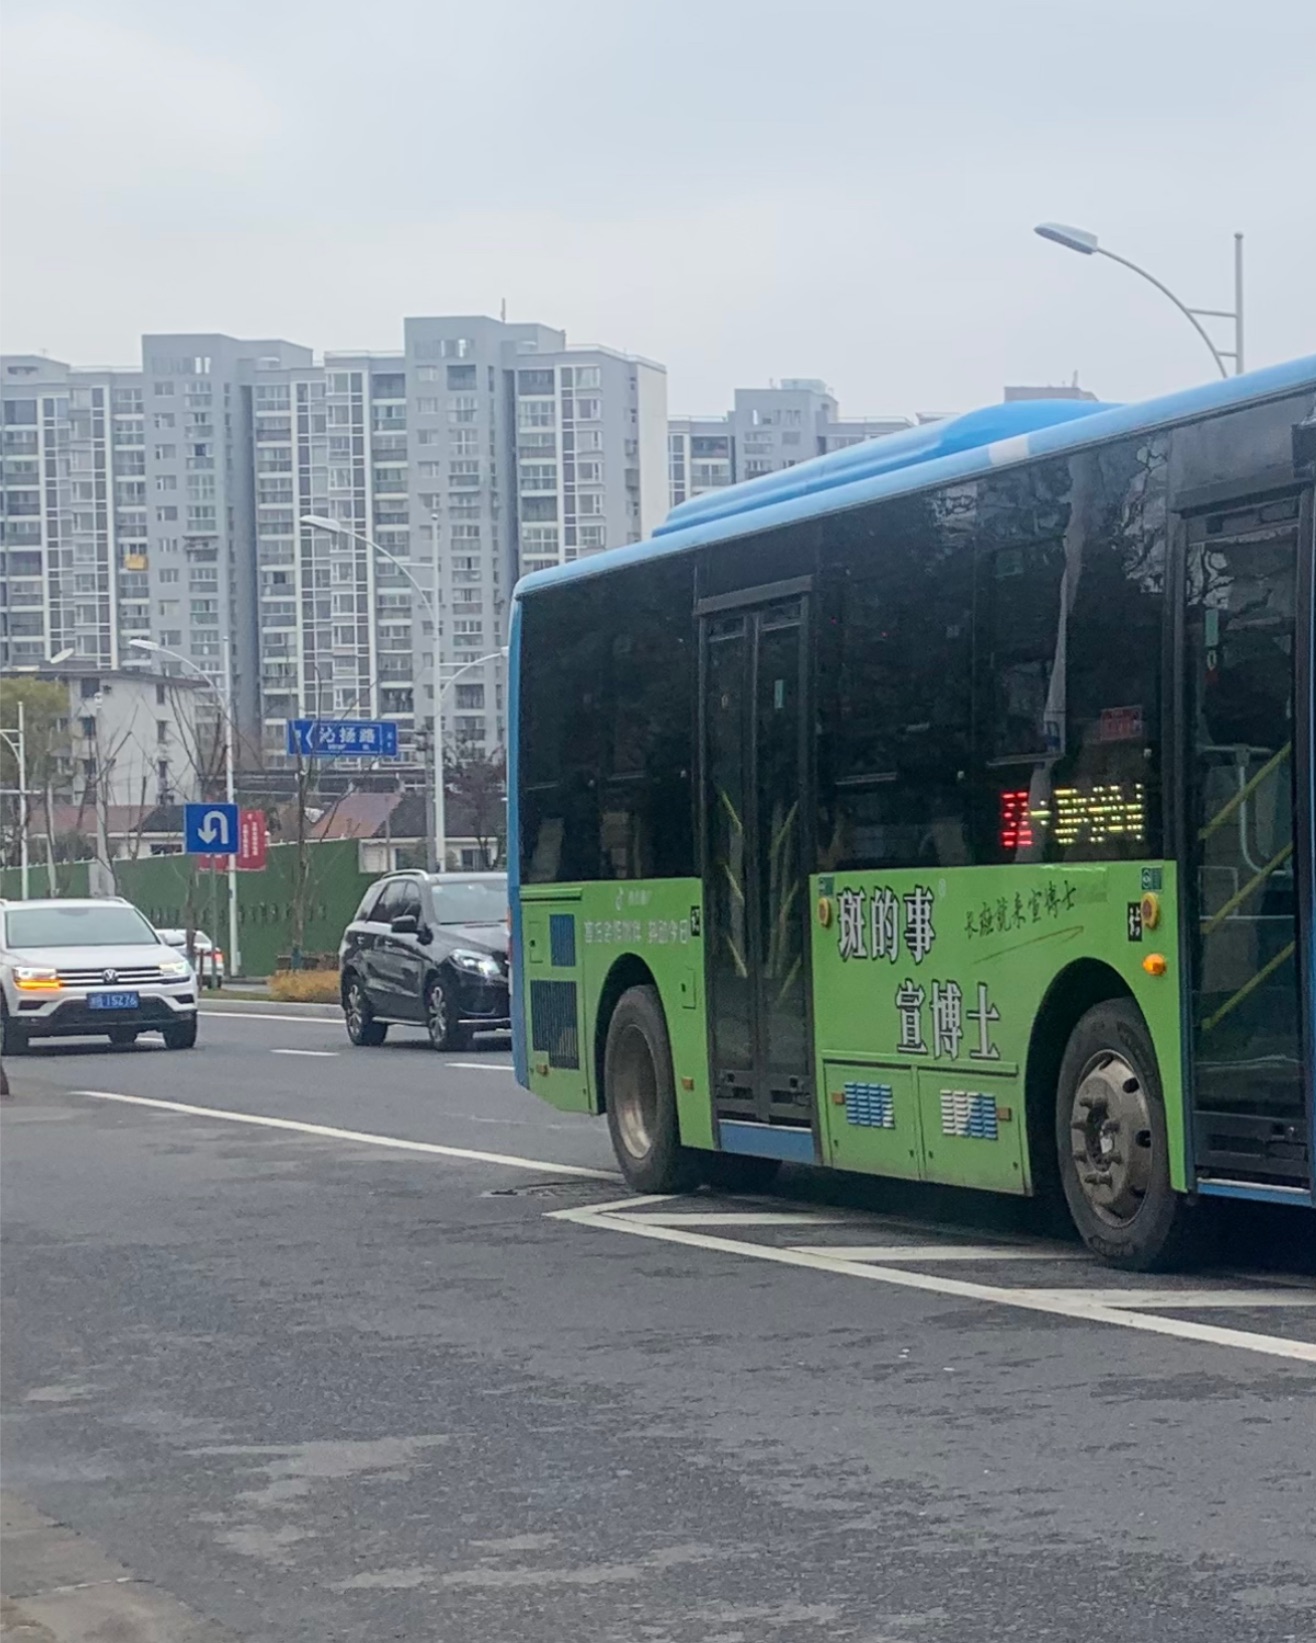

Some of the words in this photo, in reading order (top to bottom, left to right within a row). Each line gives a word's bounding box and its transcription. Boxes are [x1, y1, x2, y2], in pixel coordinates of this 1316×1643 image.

[837, 884, 936, 964] 斑的事
[895, 977, 1000, 1060] 宣博士
